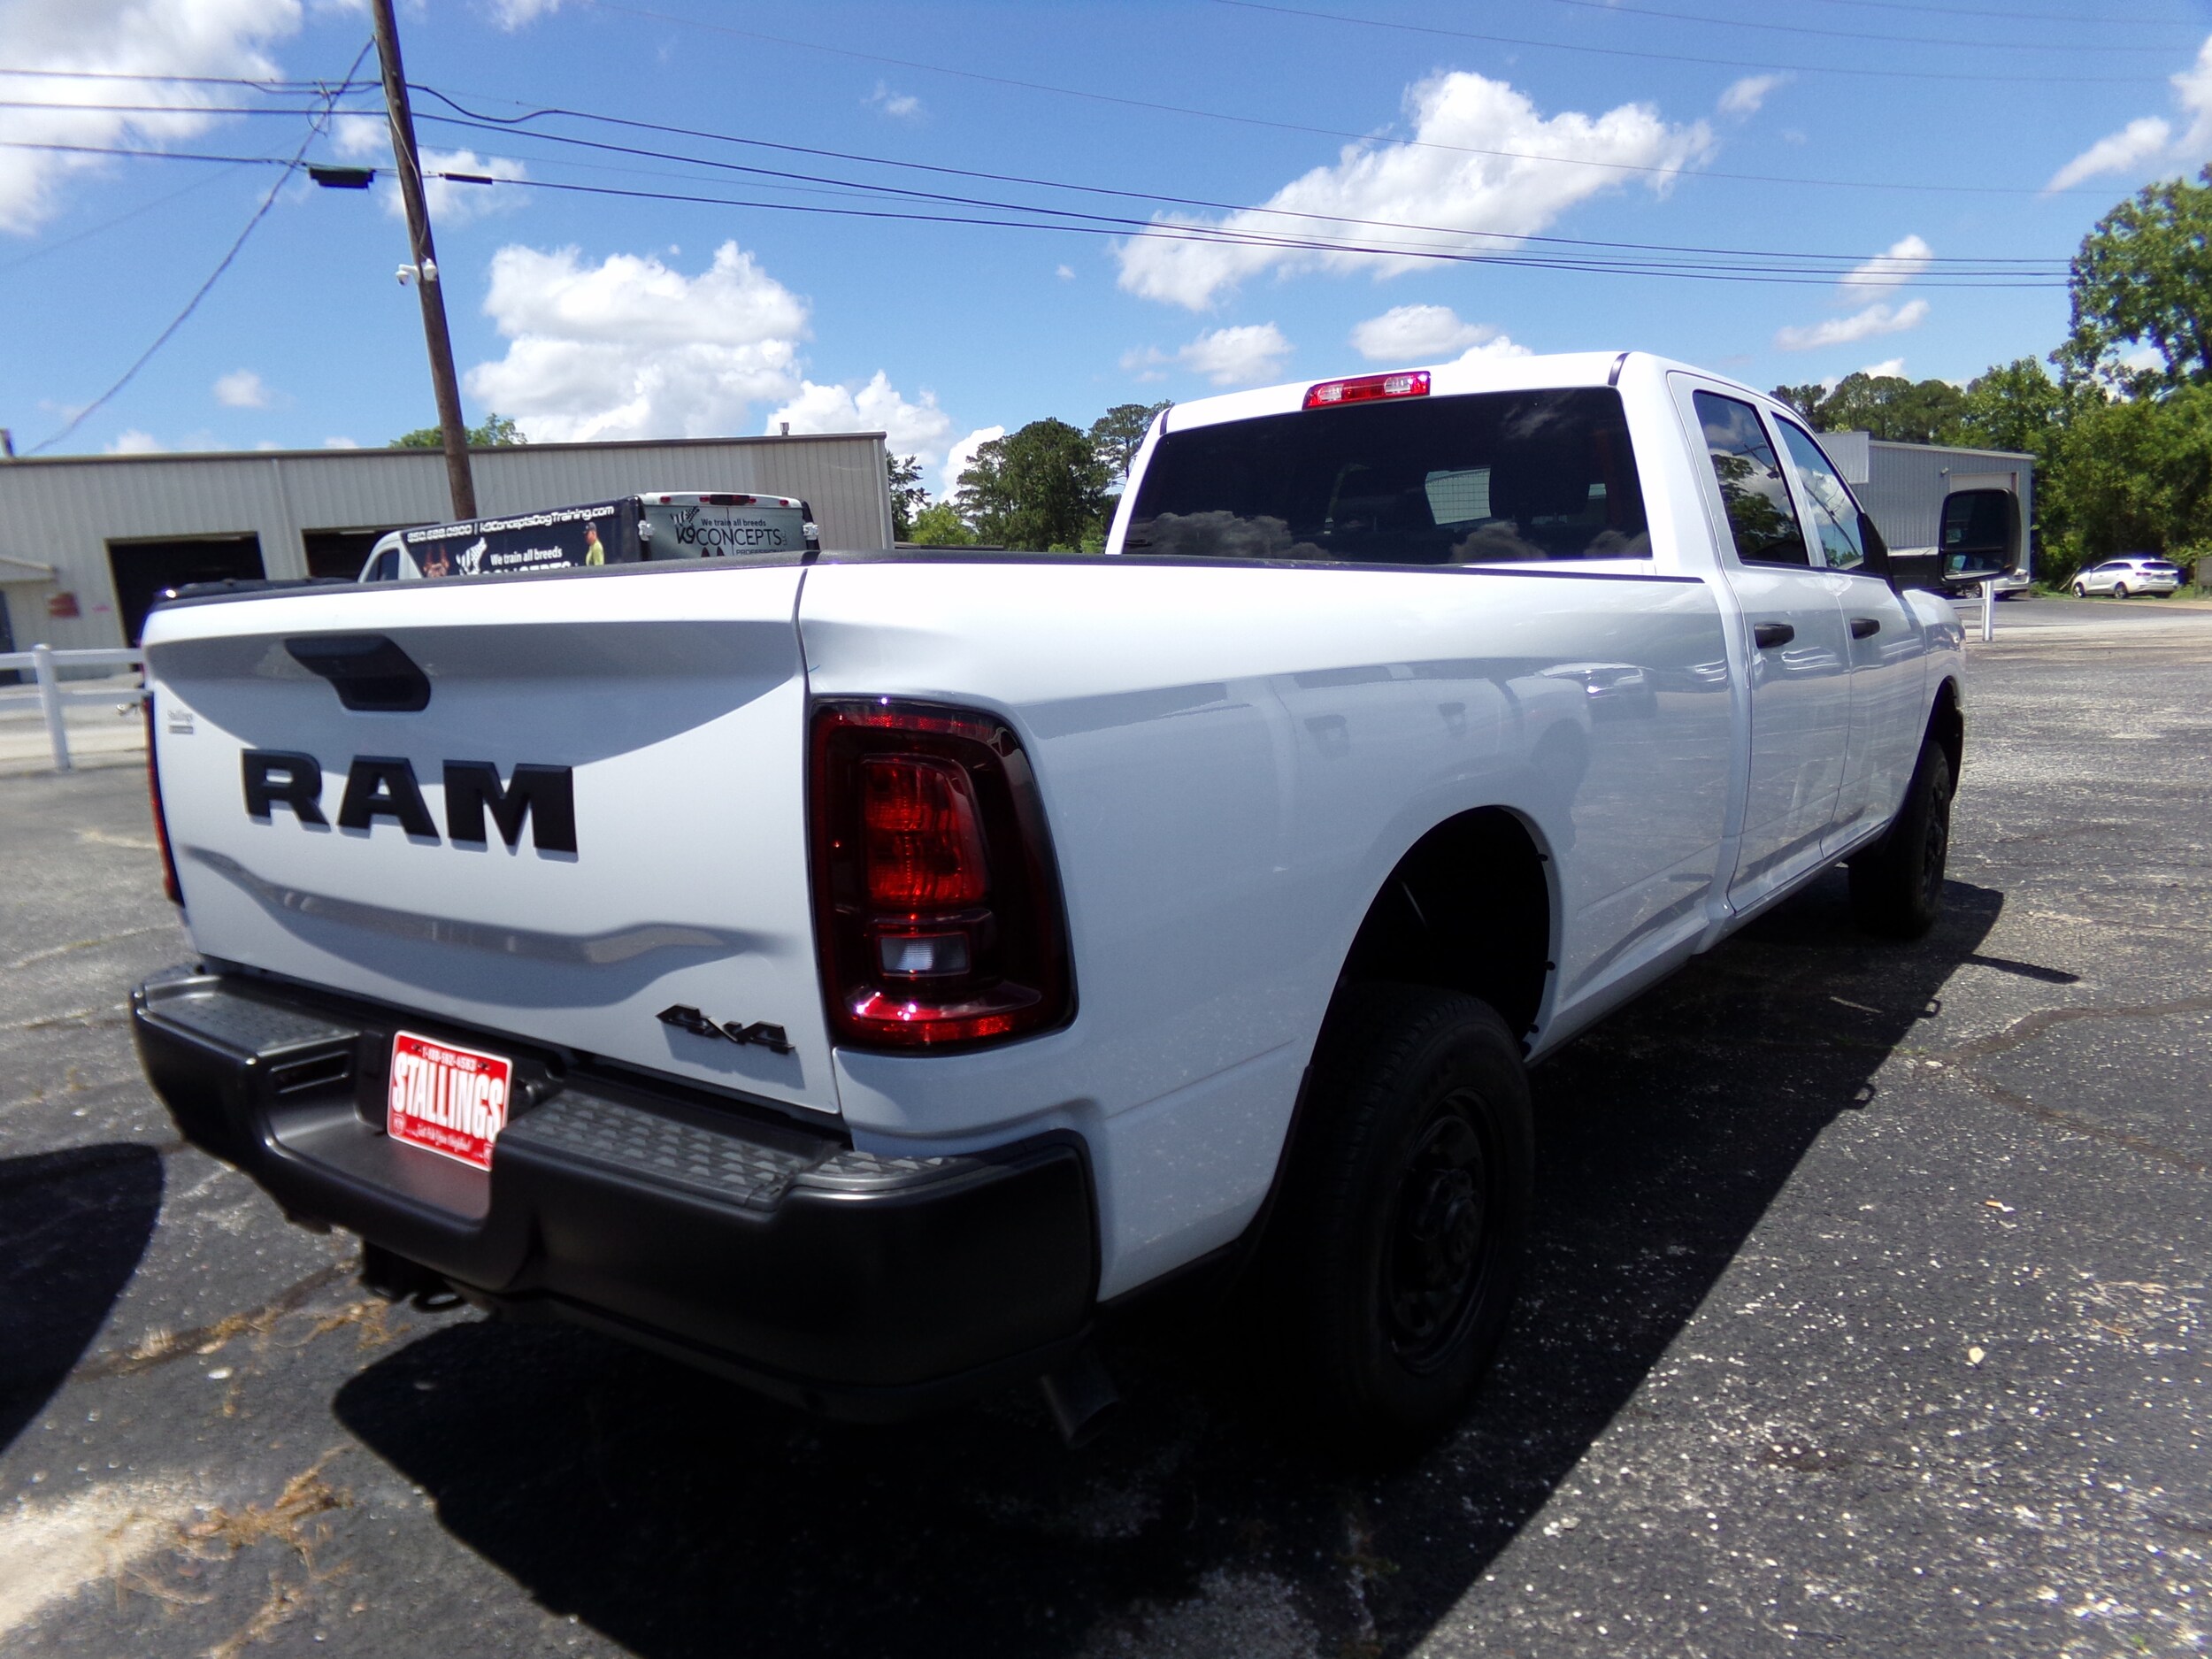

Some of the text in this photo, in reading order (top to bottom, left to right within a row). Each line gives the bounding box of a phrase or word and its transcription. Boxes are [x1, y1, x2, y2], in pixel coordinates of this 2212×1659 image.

[490, 546, 563, 566] We train all breeds
[240, 748, 577, 855] RAM
[391, 1051, 505, 1144] STALLINGS
